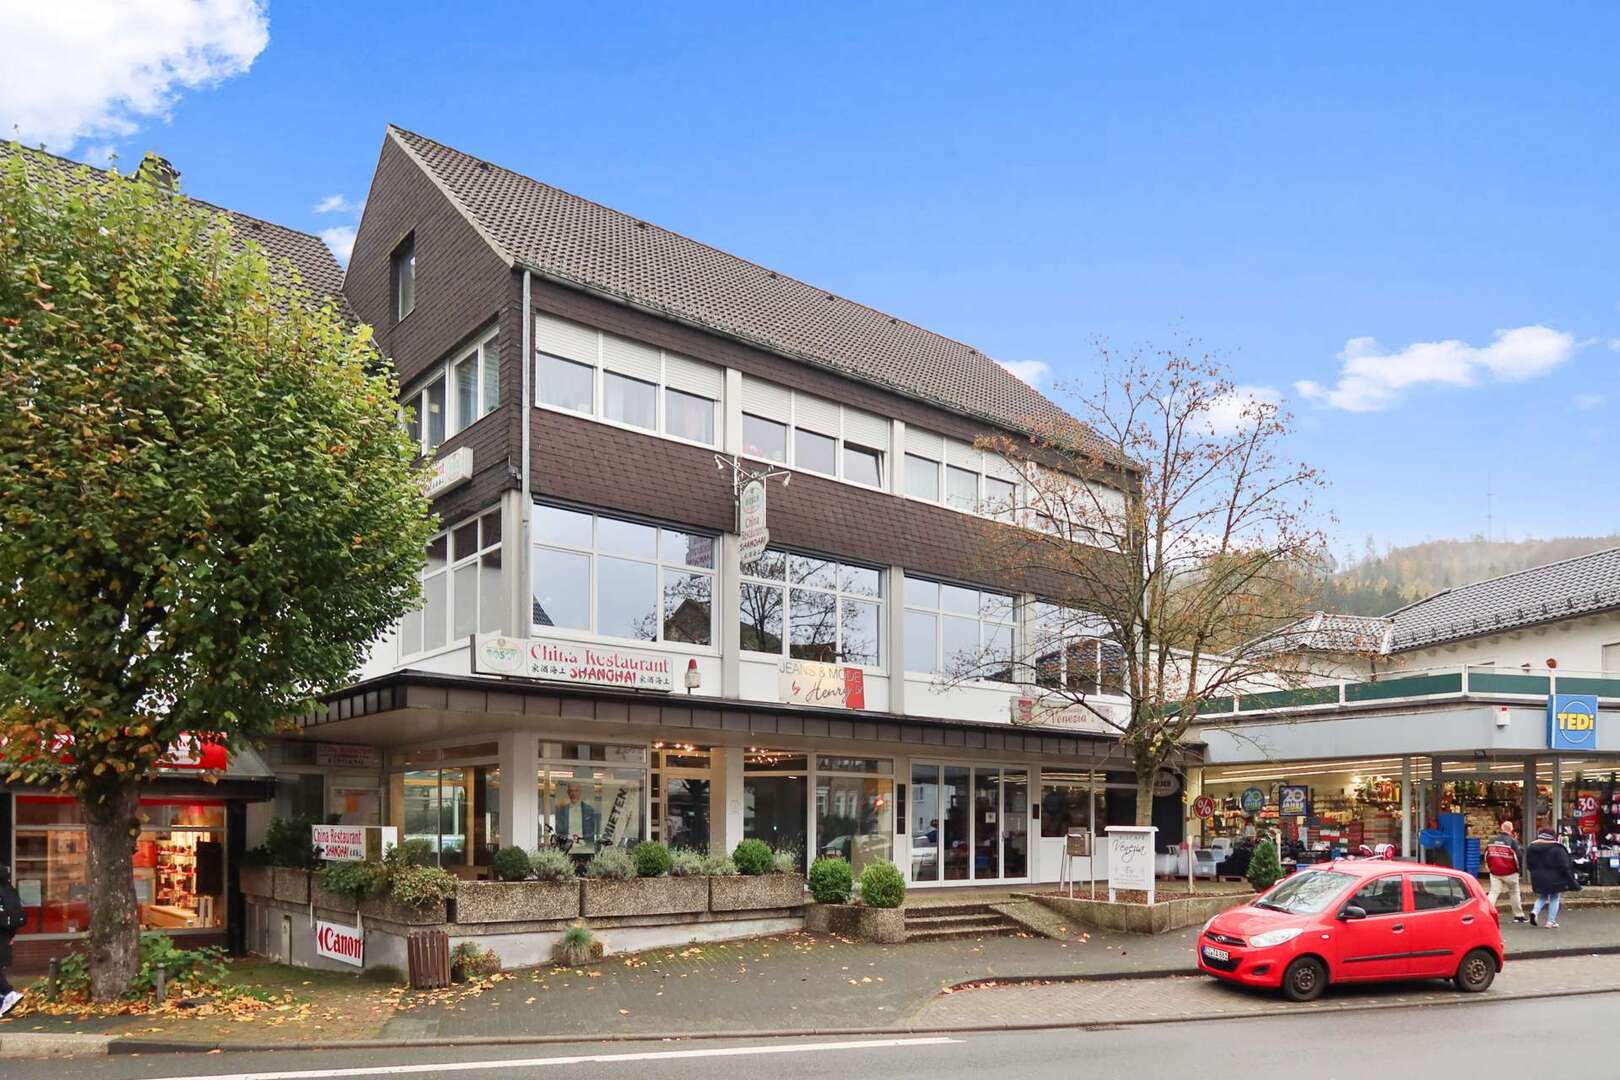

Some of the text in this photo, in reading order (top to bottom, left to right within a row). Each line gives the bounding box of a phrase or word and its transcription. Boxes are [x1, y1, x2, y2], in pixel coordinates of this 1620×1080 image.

[530, 644, 578, 663] China
[585, 649, 670, 673] Restaurant
[569, 667, 637, 684] SHANGHAI
[779, 662, 816, 677] JEANS
[829, 667, 862, 682] MODE
[1557, 713, 1594, 730] TEDi
[1283, 789, 1304, 802] 20
[601, 788, 627, 845] MIETEN
[313, 828, 361, 844] China Restaurant
[324, 927, 361, 959] Canon
